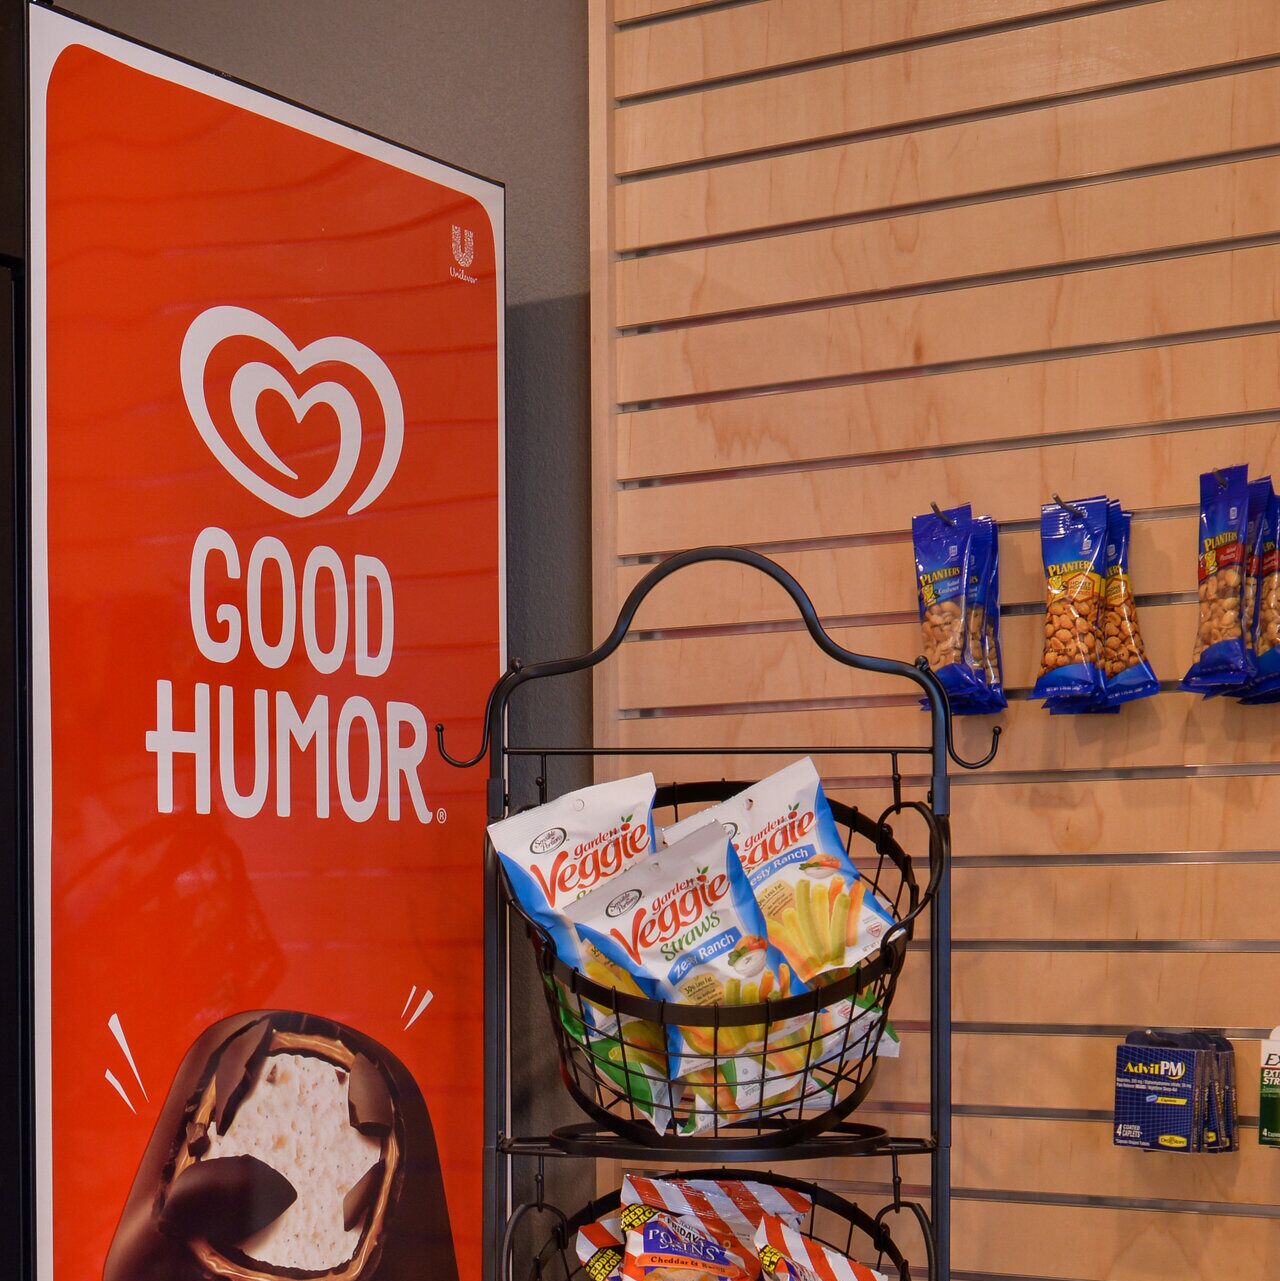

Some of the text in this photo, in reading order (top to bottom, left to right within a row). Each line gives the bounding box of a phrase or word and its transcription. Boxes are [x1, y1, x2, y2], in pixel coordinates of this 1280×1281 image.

[450, 266, 479, 285] Unilever
[920, 567, 961, 586] PLANTERS
[1046, 560, 1096, 577] PLANTERS
[189, 525, 395, 678] GOOD
[145, 679, 434, 824] HUMOR
[572, 828, 620, 860] garden
[743, 816, 787, 850] garden
[530, 820, 651, 909] Veggie
[773, 848, 810, 870] Ranch
[651, 877, 696, 916] garden
[609, 872, 731, 966] Veggie
[660, 910, 722, 963] Straws
[697, 932, 735, 961] Ranch
[650, 1256, 689, 1267] Cheddar
